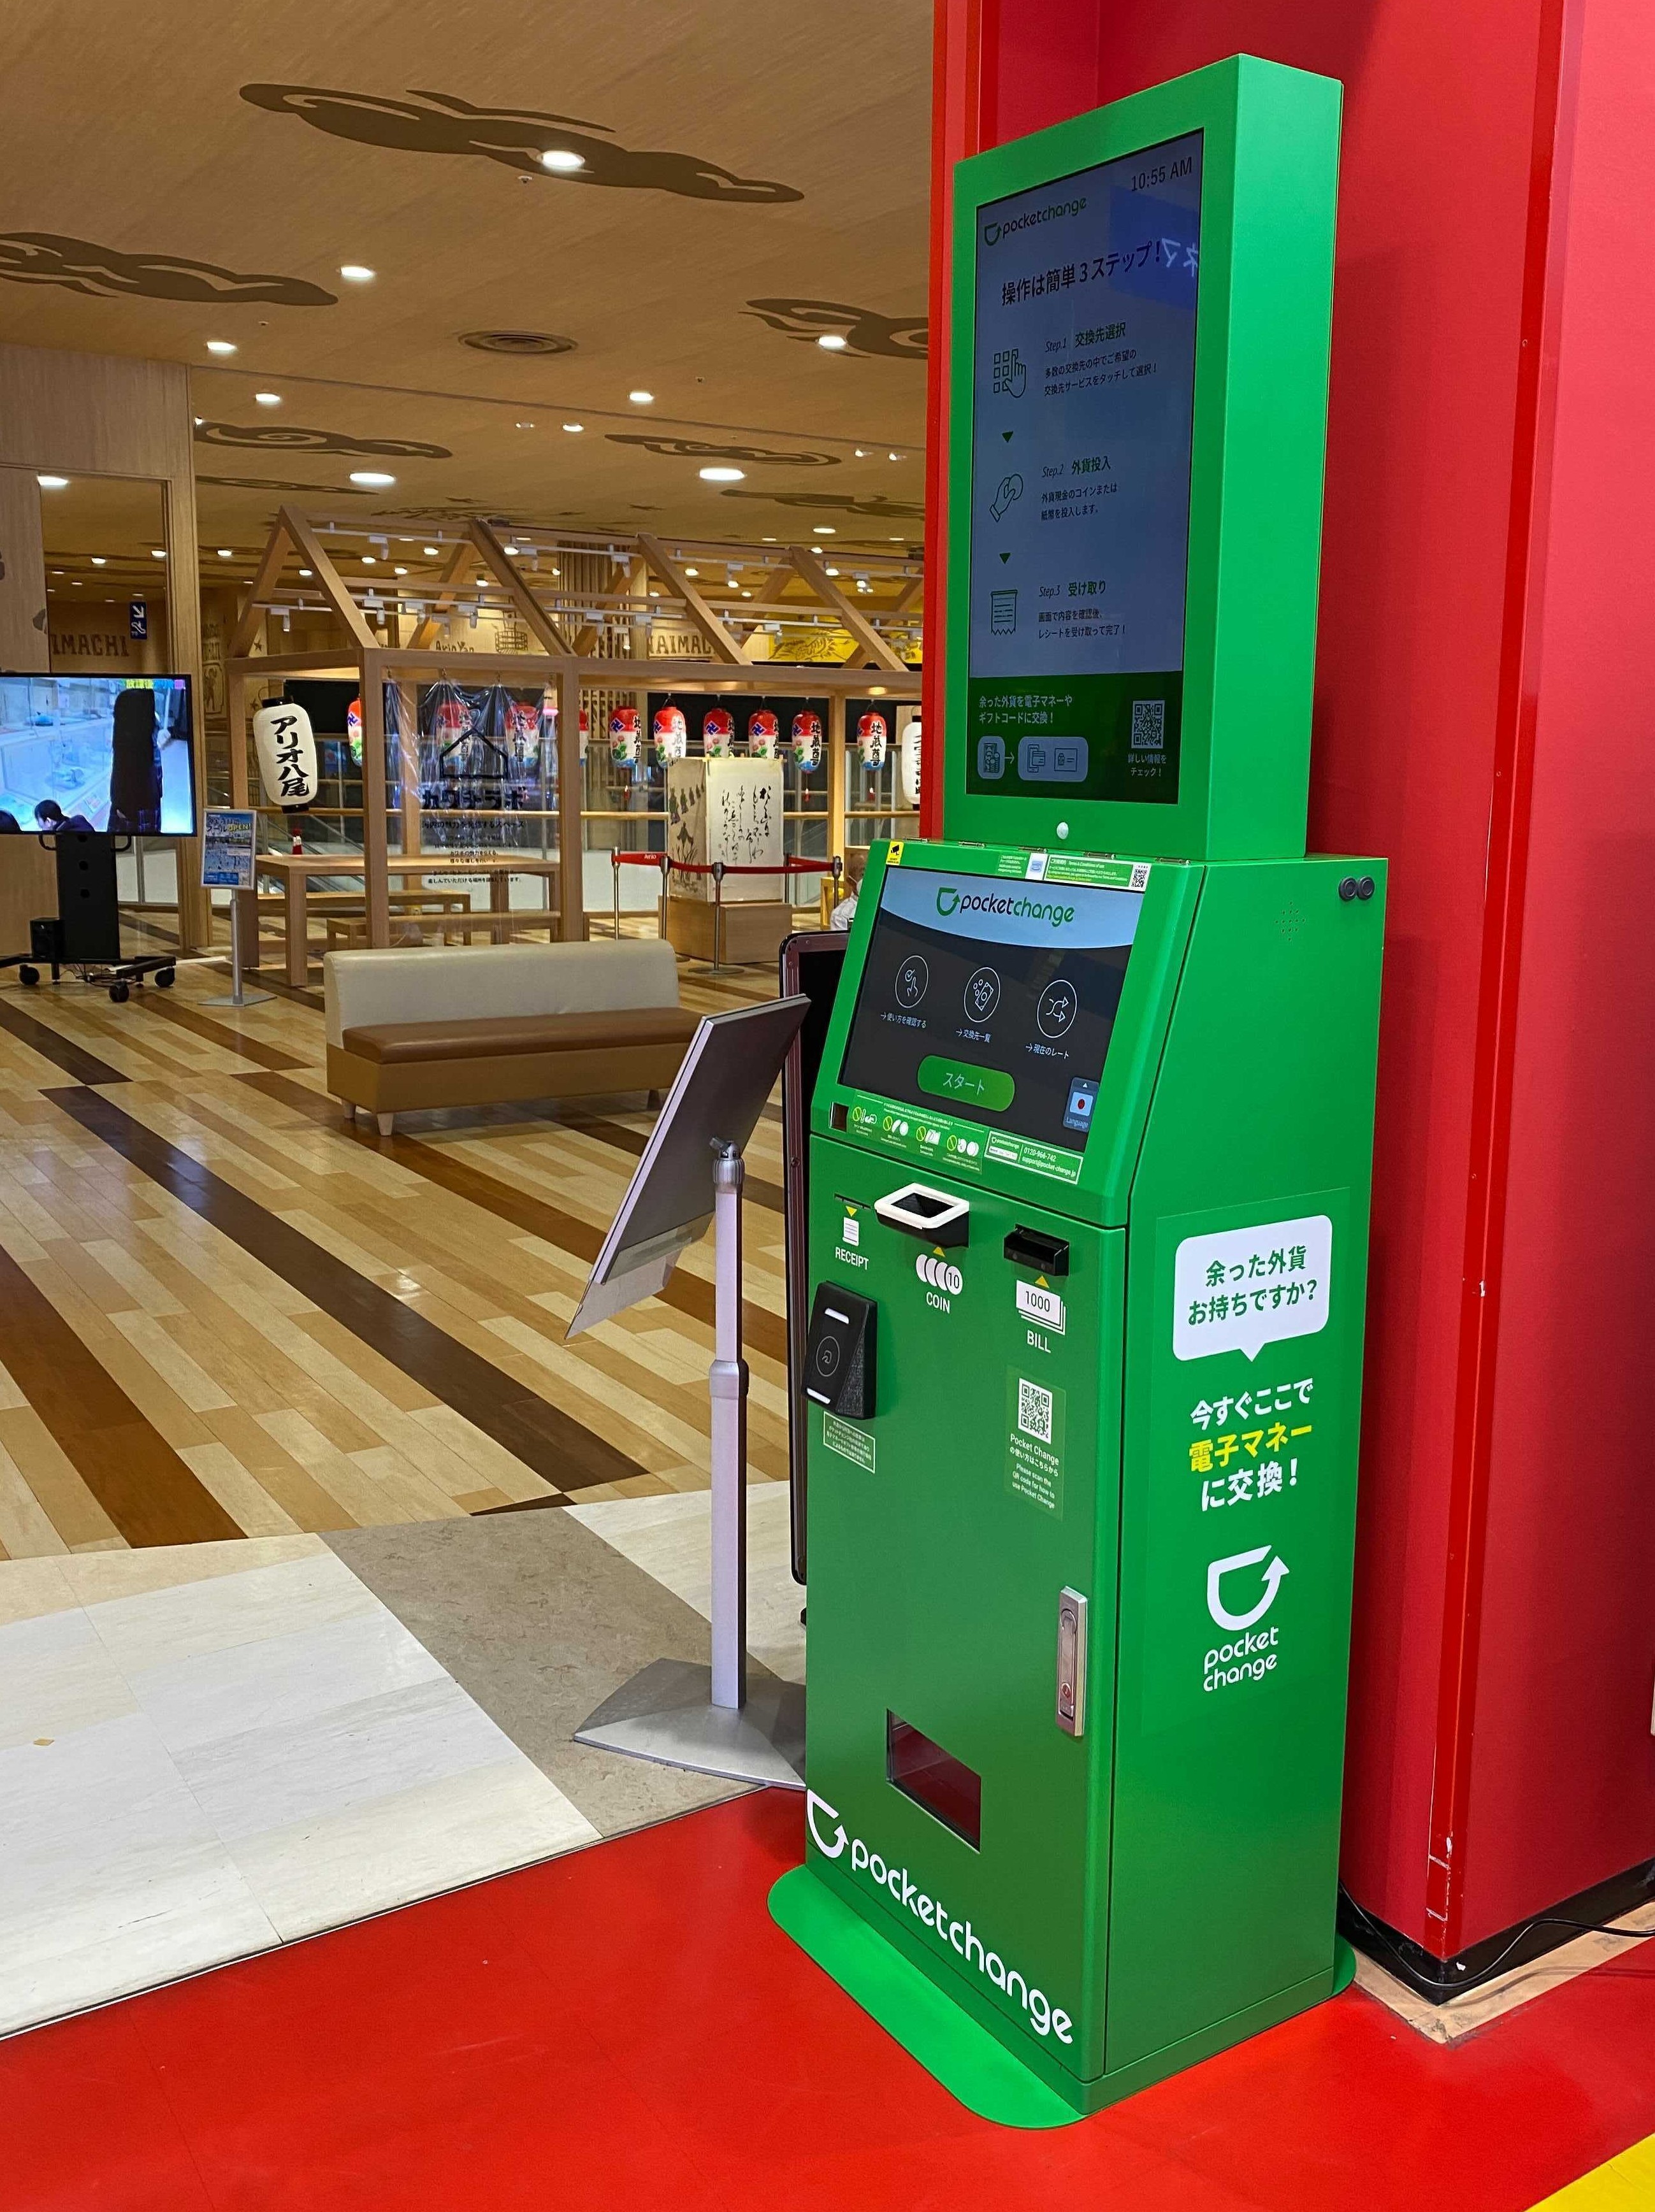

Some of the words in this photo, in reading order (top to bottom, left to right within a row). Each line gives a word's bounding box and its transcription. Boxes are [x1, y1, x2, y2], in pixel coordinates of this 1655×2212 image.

[1131, 165, 1166, 191] 10:55
[1170, 157, 1192, 180] AM
[1002, 197, 1087, 238] pocketchange
[1075, 322, 1126, 348] 交換先選択
[1071, 456, 1111, 475] 外貨投入
[1068, 580, 1106, 596] 受け取り
[979, 695, 1073, 709] 余った外貨を電子マネーや
[270, 715, 310, 797] アリオ八尾
[960, 893, 1075, 928] pocketchange
[1033, 1044, 1069, 1059] 現在のレート
[943, 1072, 985, 1096] スタート
[835, 1246, 869, 1270] RECEIPT
[1205, 1244, 1307, 1287] 余った外貨
[948, 1272, 960, 1288] 10
[926, 1291, 950, 1314] COIN
[1025, 1291, 1050, 1312] 1000
[1027, 1329, 1052, 1353] BILL
[1190, 1377, 1314, 1431] 今すぐここで
[1010, 1433, 1032, 1453] Pocket
[1034, 1445, 1059, 1466] Change
[1189, 1421, 1313, 1473] 電子マネー
[1021, 1484, 1037, 1499] Pocket
[1201, 1457, 1299, 1512] に交換！
[1204, 1626, 1279, 1675] pocket
[1203, 1654, 1278, 1692] change
[851, 1838, 1074, 2044] pocketchange
